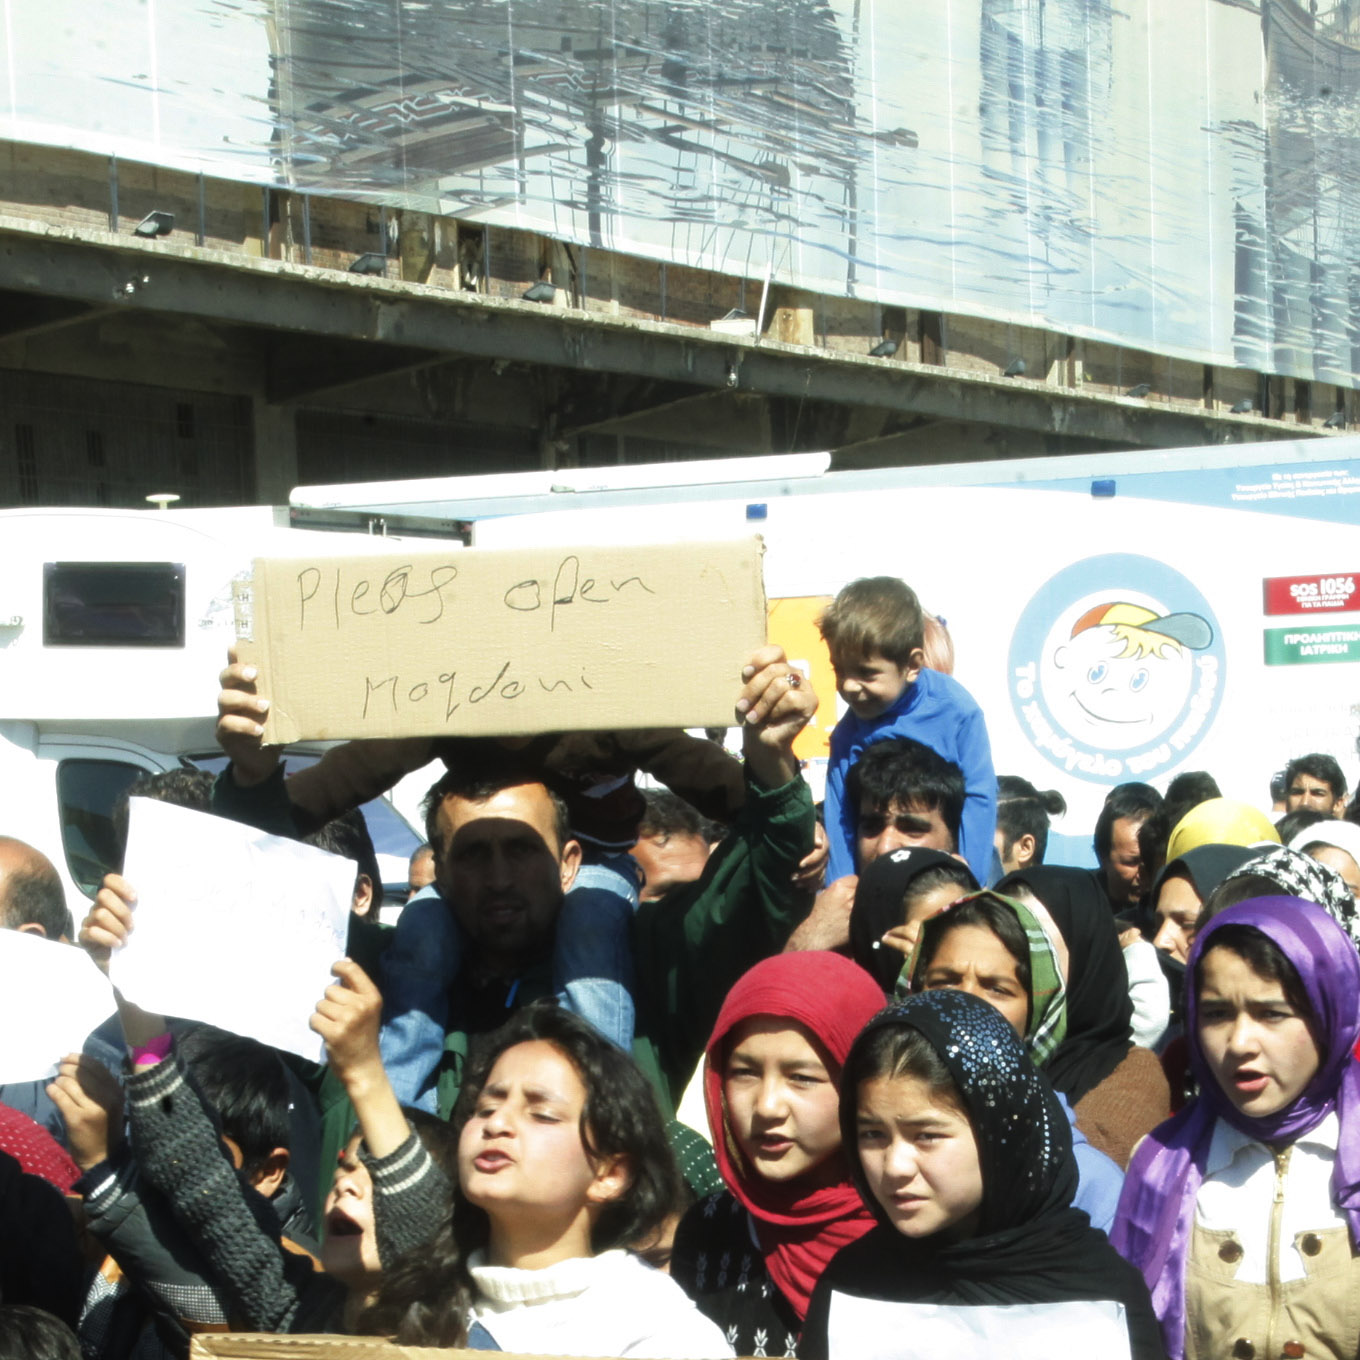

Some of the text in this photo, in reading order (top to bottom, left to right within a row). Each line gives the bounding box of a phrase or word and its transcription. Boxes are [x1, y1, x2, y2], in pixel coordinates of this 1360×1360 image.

[1289, 577, 1356, 597] SOS 1056
[1300, 644, 1348, 656] ΙΑΤΡΙΚΗ
